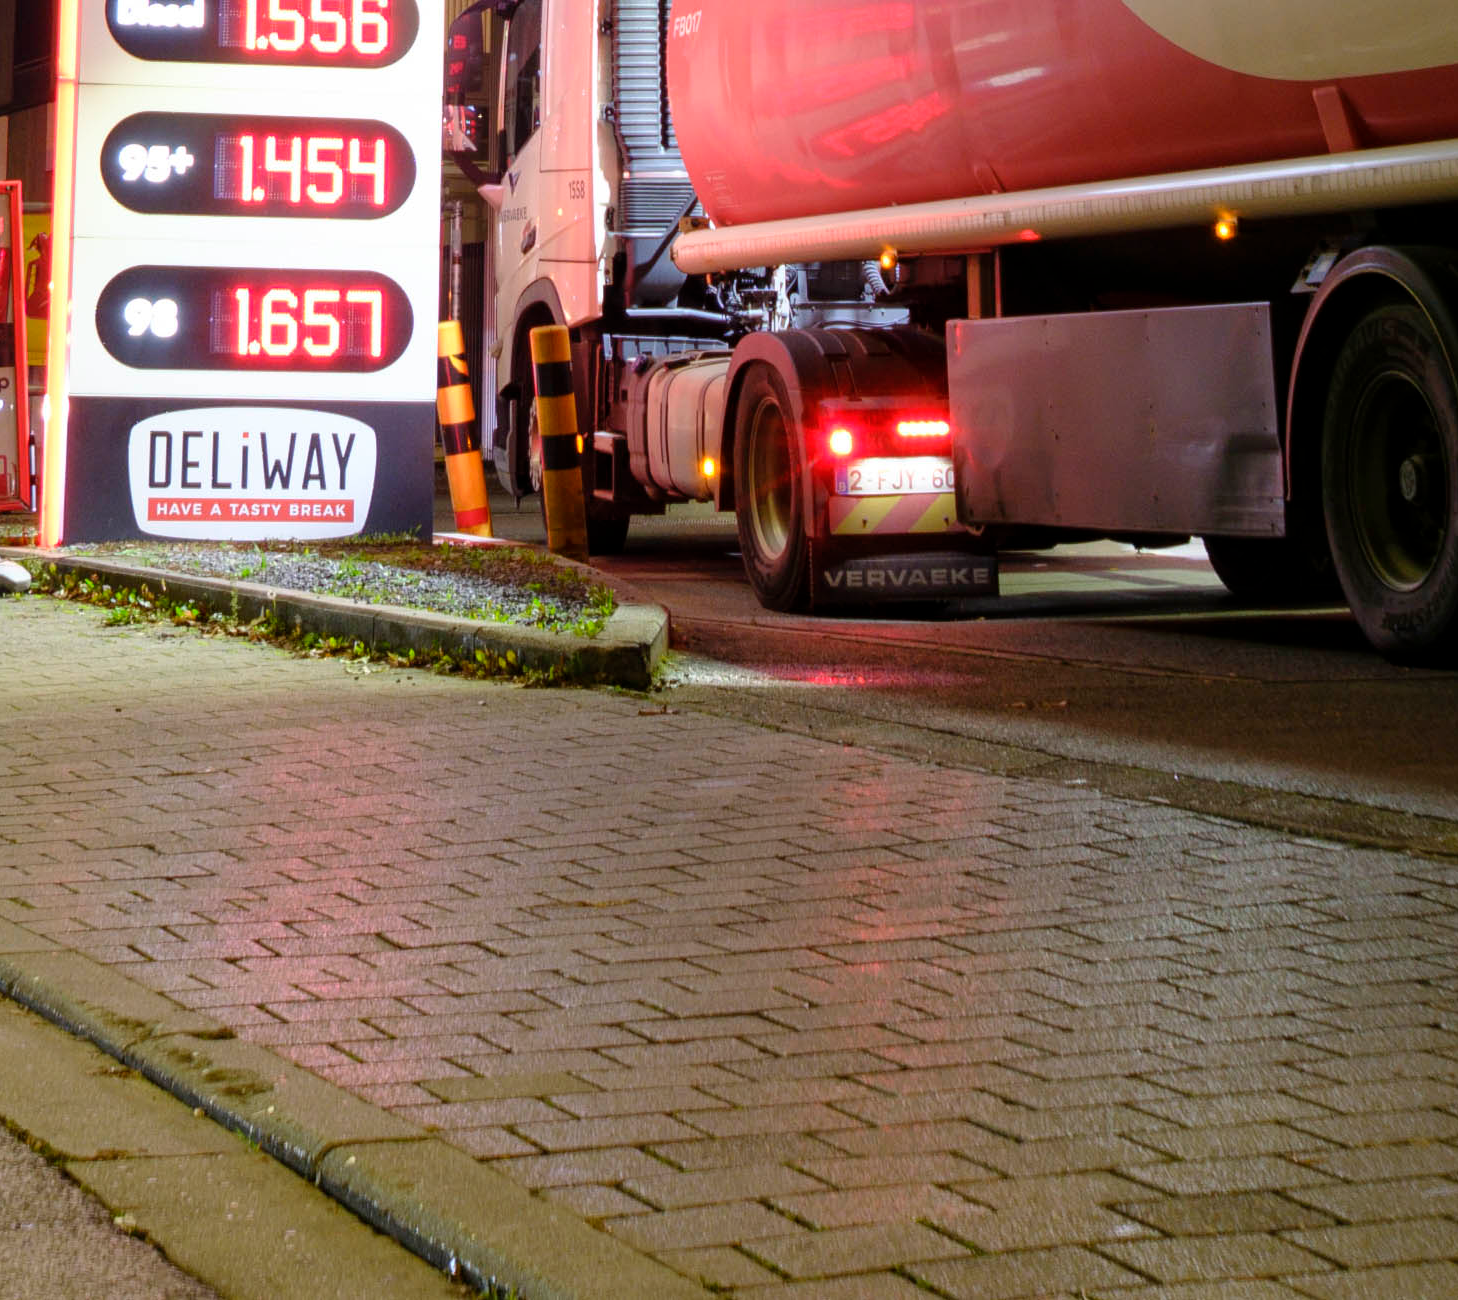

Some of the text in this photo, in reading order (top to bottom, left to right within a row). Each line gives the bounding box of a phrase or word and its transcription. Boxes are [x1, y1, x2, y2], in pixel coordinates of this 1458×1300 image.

[118, 136, 385, 205] 95+ 1.454
[236, 288, 382, 357] 1.657
[156, 503, 346, 517] HAVE A TASTY BREAK
[825, 567, 990, 589] VERVAEKE
